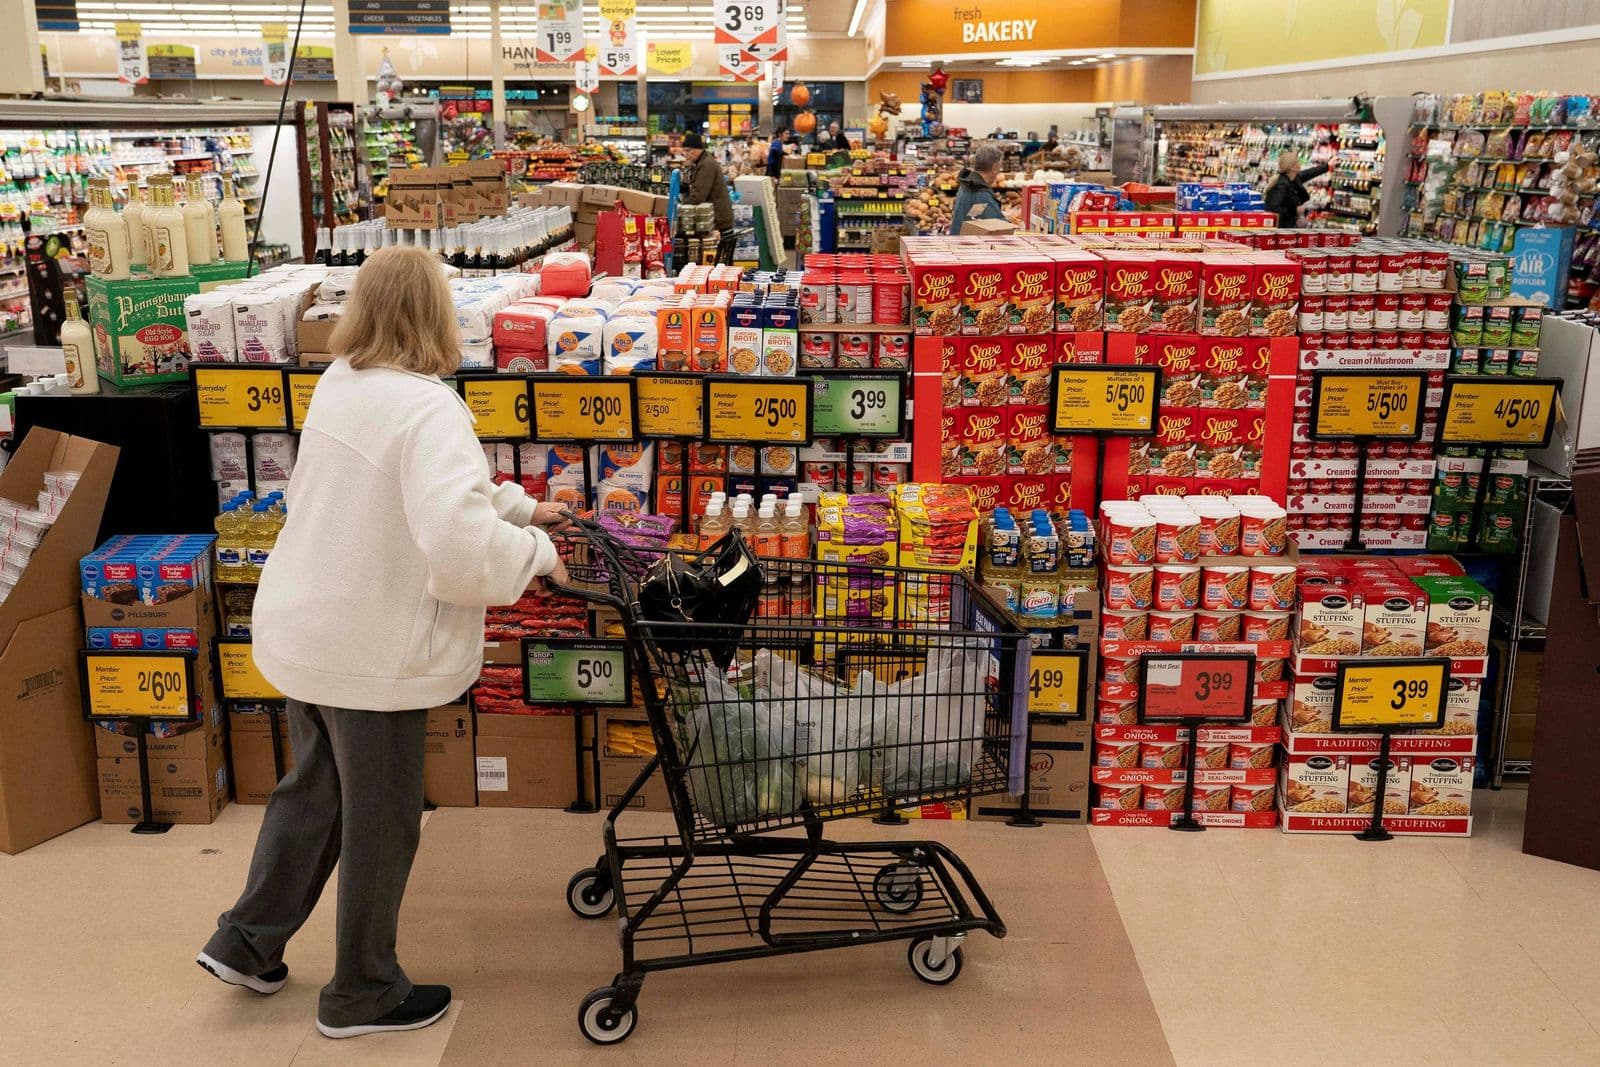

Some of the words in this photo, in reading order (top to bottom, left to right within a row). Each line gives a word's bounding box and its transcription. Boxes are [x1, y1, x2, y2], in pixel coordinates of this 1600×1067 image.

[954, 6, 982, 21] fresh
[962, 19, 1037, 43] BAKERY
[502, 47, 536, 59] HAN
[656, 56, 682, 64] Prices
[1519, 259, 1544, 275] AIR
[918, 273, 955, 296] Stove
[964, 272, 1002, 296] Stove
[1011, 270, 1049, 294] Stove
[1060, 269, 1097, 292] Stove
[1111, 269, 1149, 292] Stove
[1155, 268, 1193, 292] Stove
[1208, 273, 1247, 296] Stove
[1257, 273, 1295, 296] Stove
[931, 287, 950, 301] Top
[978, 286, 997, 301] Top
[1024, 284, 1043, 299] Top
[1072, 283, 1092, 297] Top
[1123, 283, 1143, 297] Top
[1168, 282, 1187, 297] Top
[1221, 287, 1240, 301] Top
[114, 292, 194, 332] Pennsylvan
[156, 304, 184, 318] Dut
[1338, 357, 1364, 365] Cream
[1364, 357, 1373, 365] of
[1373, 357, 1414, 365] Mushroom
[197, 385, 227, 393] Everyday!
[607, 500, 636, 510] GOLD
[1319, 538, 1343, 546] Cream
[1439, 616, 1481, 624] STUFFING
[455, 730, 467, 738] UP
[1123, 732, 1159, 740] ONIONS
[1315, 739, 1391, 747] TRADITION
[1396, 740, 1451, 748] STUFFING
[1119, 774, 1155, 782] ONIONS
[1118, 817, 1153, 825] ONIONS
[1310, 818, 1386, 827] TRADITIONL
[1390, 819, 1446, 828] STUFFING
